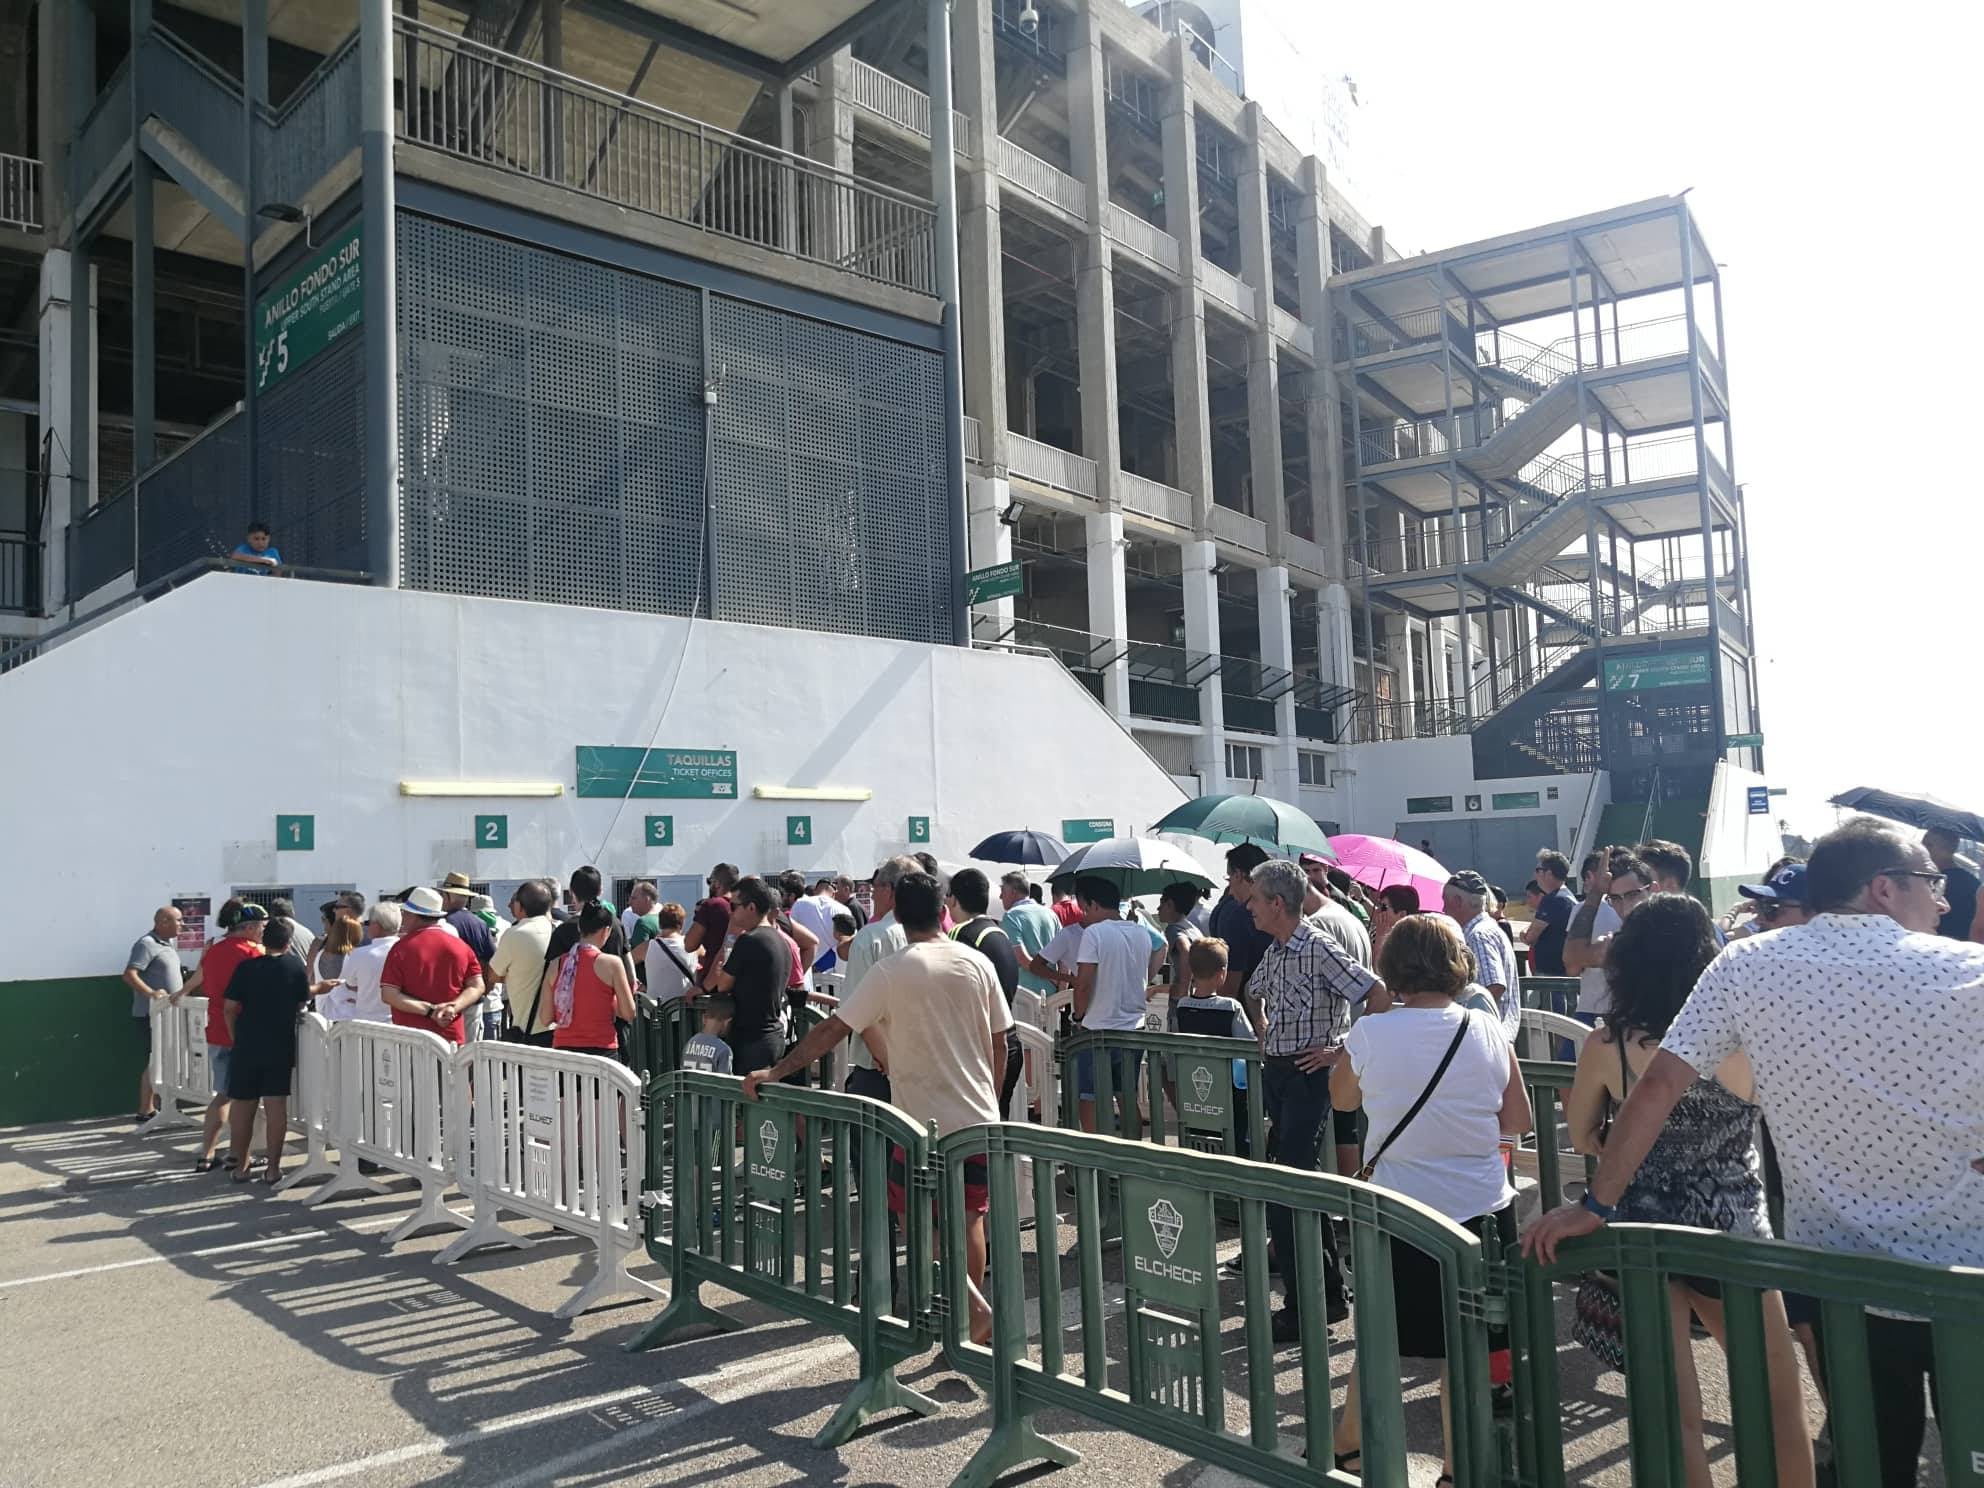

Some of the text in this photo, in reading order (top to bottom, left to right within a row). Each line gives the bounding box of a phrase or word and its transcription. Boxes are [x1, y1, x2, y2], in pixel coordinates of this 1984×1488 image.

[265, 237, 360, 329] ANILLO FONDO SUR
[320, 278, 341, 301] STAND
[342, 263, 360, 283] AREA
[277, 331, 289, 373] 5
[1628, 673, 1640, 689] 7
[667, 754, 732, 766] TAQUILLAS
[672, 768, 732, 777] TICKET OFFICES
[1468, 798, 1479, 810] 6
[289, 822, 301, 842] 1
[485, 822, 499, 841] 2
[654, 821, 666, 839] 3
[794, 821, 805, 838] 4
[915, 821, 924, 837] 5
[1183, 1102, 1224, 1115] ELCHECF
[750, 1163, 786, 1181] ELCHECF
[1134, 1255, 1202, 1286] ELCHECF
